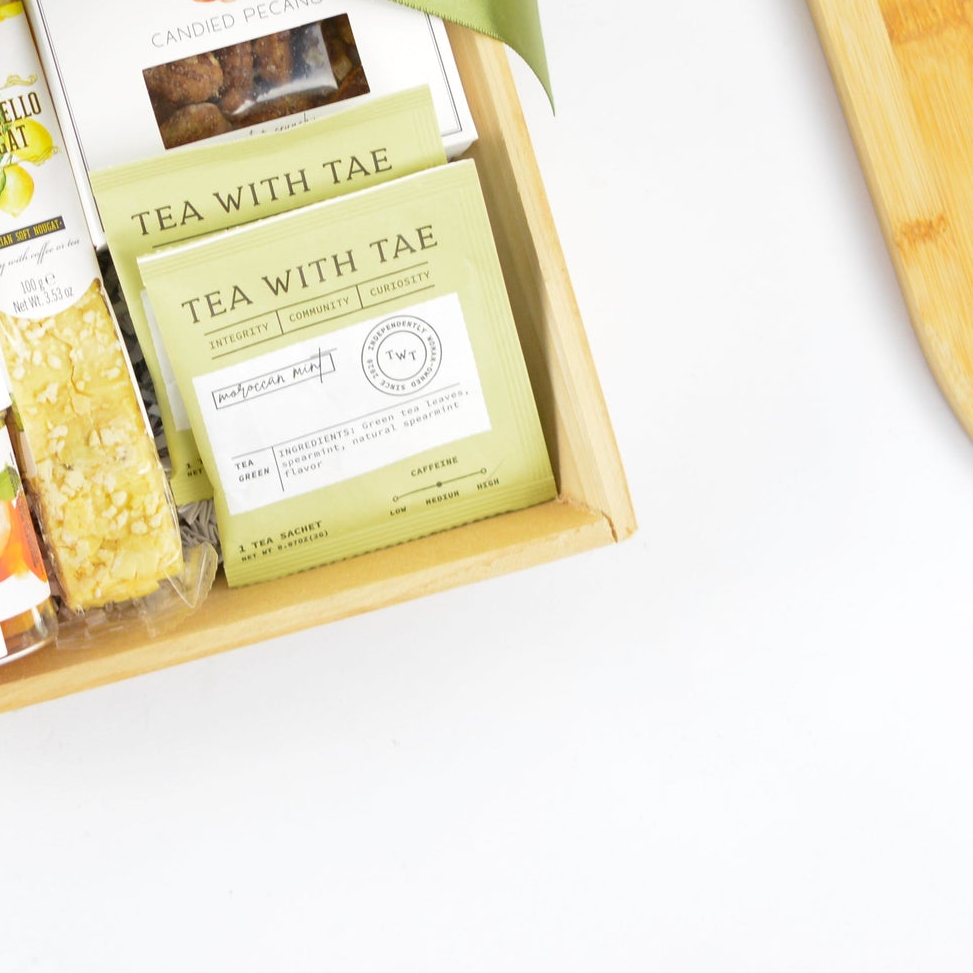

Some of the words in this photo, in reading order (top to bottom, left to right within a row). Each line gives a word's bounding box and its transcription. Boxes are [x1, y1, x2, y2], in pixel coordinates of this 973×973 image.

[151, 13, 235, 49] CANDIED
[131, 200, 204, 236] TEA
[212, 168, 311, 214] WITH
[322, 147, 394, 185] TAE
[15, 229, 31, 241] SOFT
[20, 278, 37, 294] 100
[38, 279, 45, 291] g
[180, 285, 253, 324] TEA
[261, 249, 357, 297] WITH
[369, 225, 439, 264] TAE
[370, 270, 431, 297] CURIOSITY
[13, 298, 27, 314] Net
[44, 287, 63, 304] 3.53
[64, 287, 74, 298] oz
[289, 297, 349, 323] COMMUNITY
[209, 322, 269, 350] INTEGRITY
[368, 320, 427, 351] INDEPENDENTLY
[385, 349, 417, 361] TWT
[218, 374, 285, 403] moroccan
[292, 347, 330, 383] mint
[380, 380, 406, 390] SINCE
[278, 427, 356, 458] INGREDIENTS:
[361, 413, 395, 430] Green
[400, 405, 420, 418] tea
[425, 389, 471, 408] leaves,
[281, 443, 346, 469] spearmint,
[351, 424, 396, 445] natural
[403, 401, 460, 428] spearmint
[235, 459, 254, 470] TEA
[238, 466, 270, 483] GREEN
[284, 461, 323, 478] flavor
[410, 456, 459, 477] CAFFEINE
[476, 477, 500, 492] HIGH
[389, 505, 407, 517] LOW
[425, 490, 460, 506] MEDIUM
[251, 537, 274, 549] TEA
[280, 520, 323, 540] SACHET
